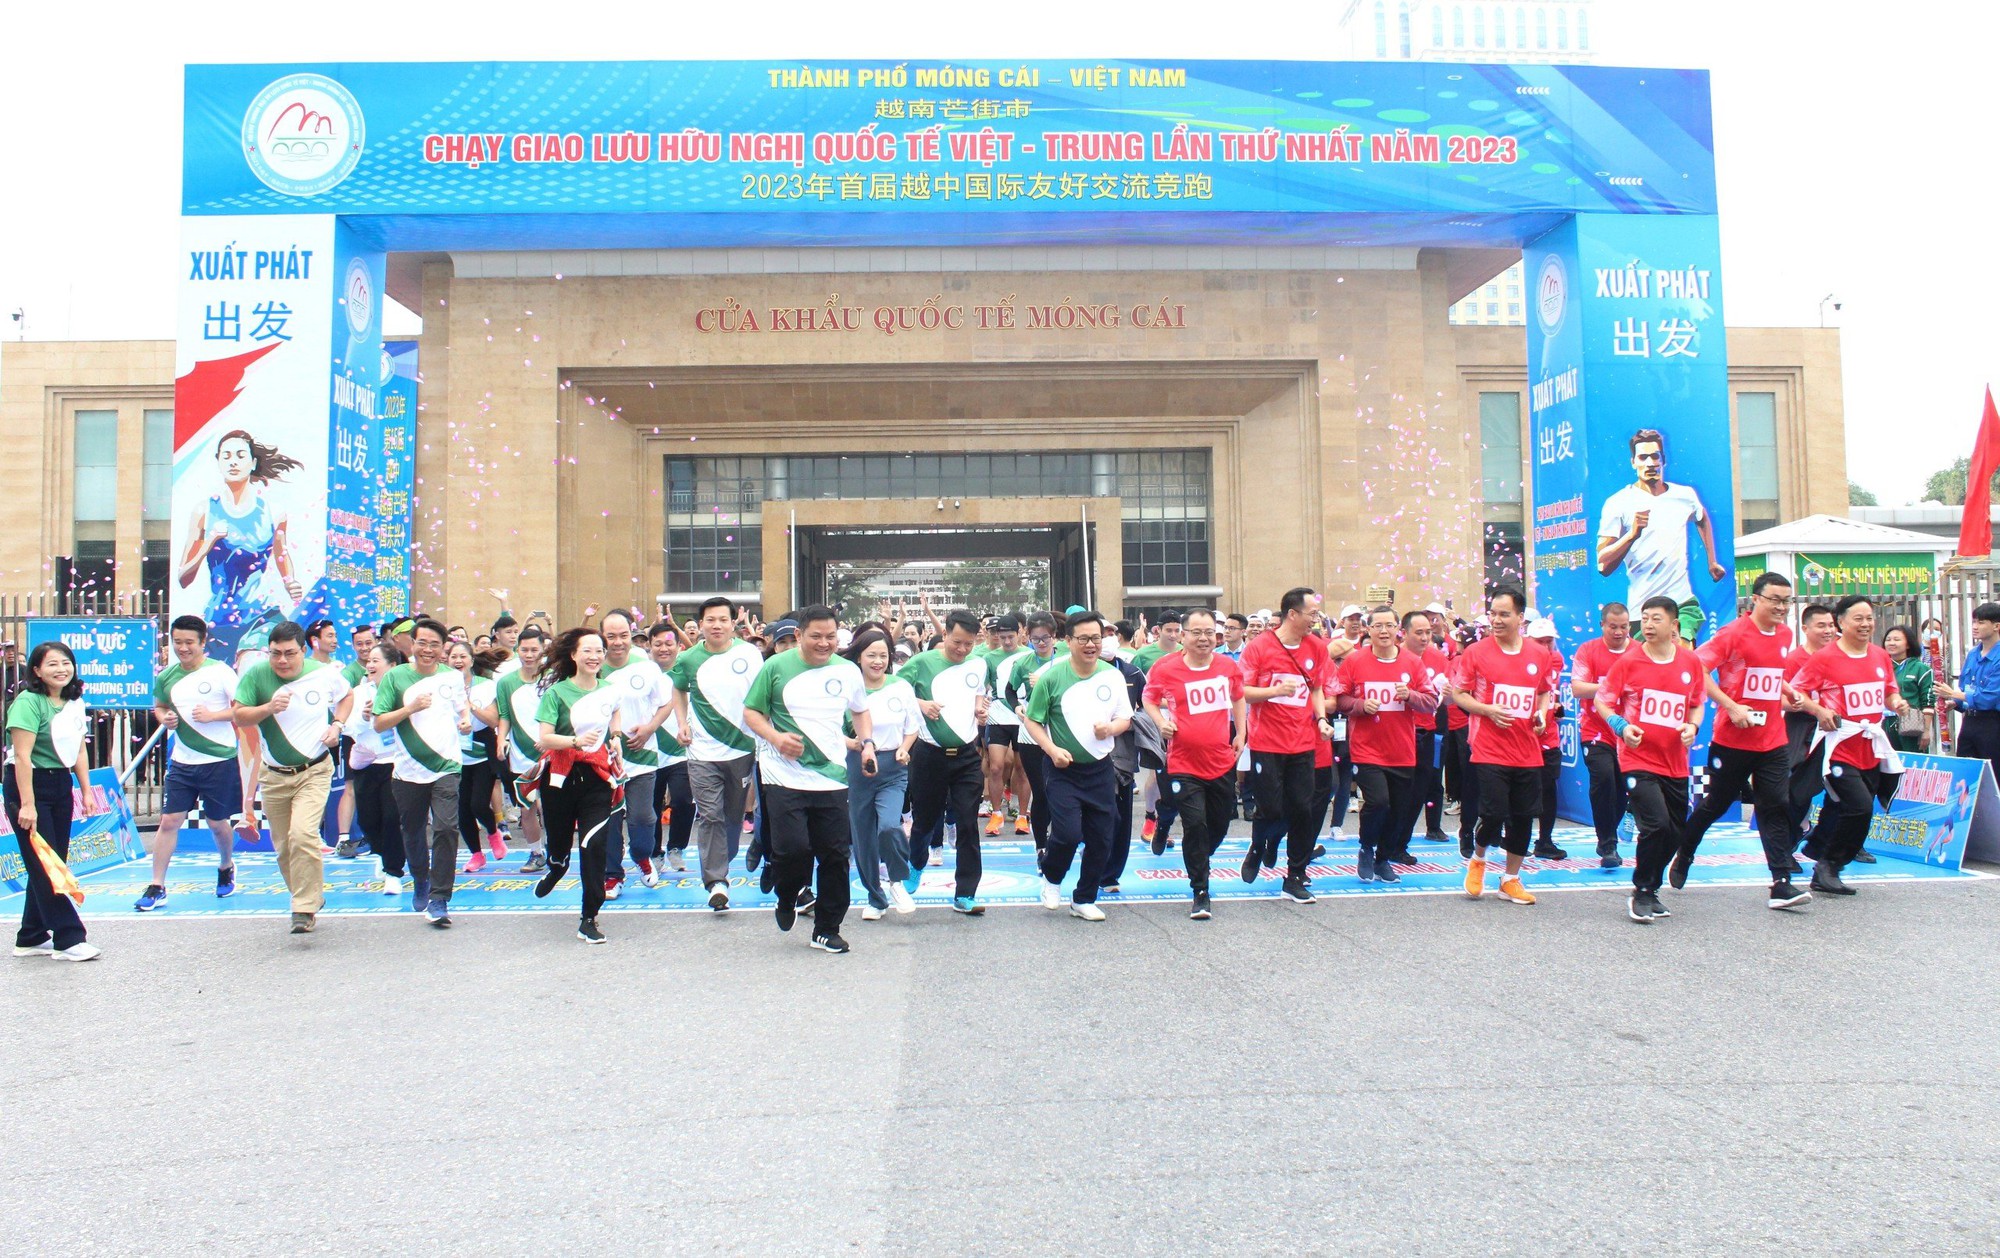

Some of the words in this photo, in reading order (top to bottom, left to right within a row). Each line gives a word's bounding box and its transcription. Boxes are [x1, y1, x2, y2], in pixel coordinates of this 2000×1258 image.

[768, 66, 850, 88] THÀNH
[857, 62, 910, 88] PHỐ
[915, 64, 990, 88] MÓNG
[998, 66, 1040, 88] CÁI
[1070, 64, 1120, 91] VIỆT
[1127, 69, 1186, 88] NAM
[874, 98, 1032, 119] 越南芒街市
[424, 133, 502, 169] CHẠY
[512, 134, 584, 163] GIAO
[591, 133, 652, 163] LƯU
[659, 128, 721, 163] HỮU
[729, 134, 804, 168] NGHỊ
[814, 122, 898, 164] QUỐC
[905, 122, 941, 162] TẾ
[950, 133, 1014, 167] VIỆT
[1044, 134, 1144, 162] TRUNG
[1153, 124, 1212, 163] LẦN
[1222, 131, 1279, 163] THỨ
[1286, 124, 1364, 164] NHẤT
[1371, 128, 1440, 163] NĂM
[1447, 134, 1518, 165] 2023
[741, 171, 1213, 202] 2023年首届越中国际友好交流竞跑
[190, 240, 248, 281] XUẤT
[255, 244, 313, 279] PHÁT
[1594, 258, 1652, 299] XUẤT
[1657, 263, 1712, 300] PHÁT
[203, 300, 294, 343] 出发
[695, 297, 760, 333] CỬA
[768, 292, 864, 332] KHẨU
[872, 294, 964, 336] QUỐC
[974, 293, 1017, 330] TẾ
[1026, 296, 1122, 329] MÓNG
[1130, 296, 1188, 328] CÁI
[1613, 317, 1701, 358] 出发
[355, 383, 376, 419] PHÁT
[1532, 369, 1554, 413] XUẤT
[1555, 363, 1578, 404] PHÁT
[337, 427, 369, 475] 出发
[1540, 420, 1574, 465] 出发
[60, 633, 92, 650] KHU
[1190, 685, 1227, 706] 001
[1496, 691, 1533, 711] 005
[1747, 674, 1782, 694] 007
[1848, 688, 1883, 708] 008
[1644, 697, 1685, 721] 006
